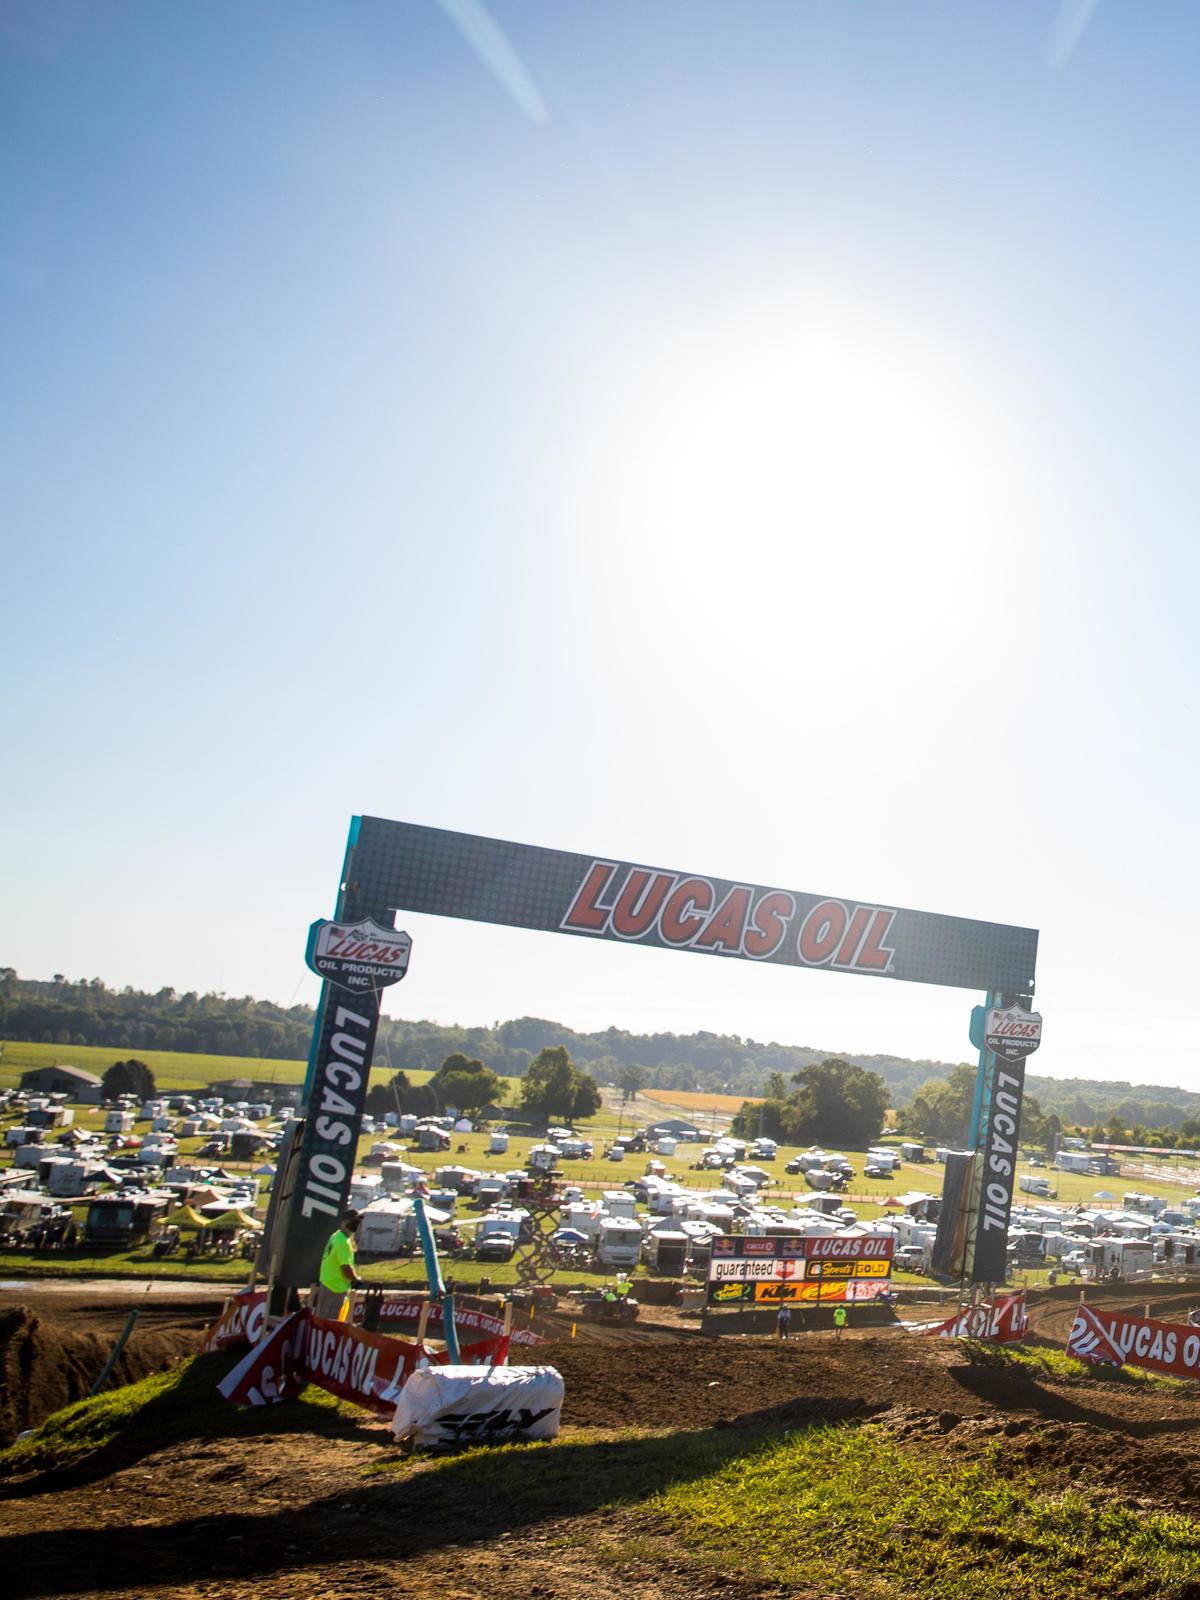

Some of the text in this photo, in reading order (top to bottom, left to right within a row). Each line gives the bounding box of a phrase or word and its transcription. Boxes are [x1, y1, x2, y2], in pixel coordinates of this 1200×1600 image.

[559, 860, 897, 973] LUCAS OIL
[326, 939, 406, 963] LUCAS
[318, 960, 402, 978] OIL PRODUCTS
[992, 1022, 1039, 1037] LUCAS
[1002, 1039, 1038, 1048] PRODUCTS
[301, 1005, 370, 1218] LUCAS OIL
[982, 1071, 1020, 1231] LUCAS OIL
[811, 1239, 862, 1256] LUCAS
[863, 1239, 887, 1256] OIL
[716, 1259, 774, 1280] guaranteed
[822, 1262, 885, 1275] Sports GOLD
[760, 1284, 798, 1299] KTM
[379, 1303, 419, 1317] LUCAS
[424, 1305, 436, 1319] IL
[1108, 1320, 1177, 1364] LUCAS
[306, 1327, 353, 1385] UCAS
[351, 1342, 379, 1396] OIL
